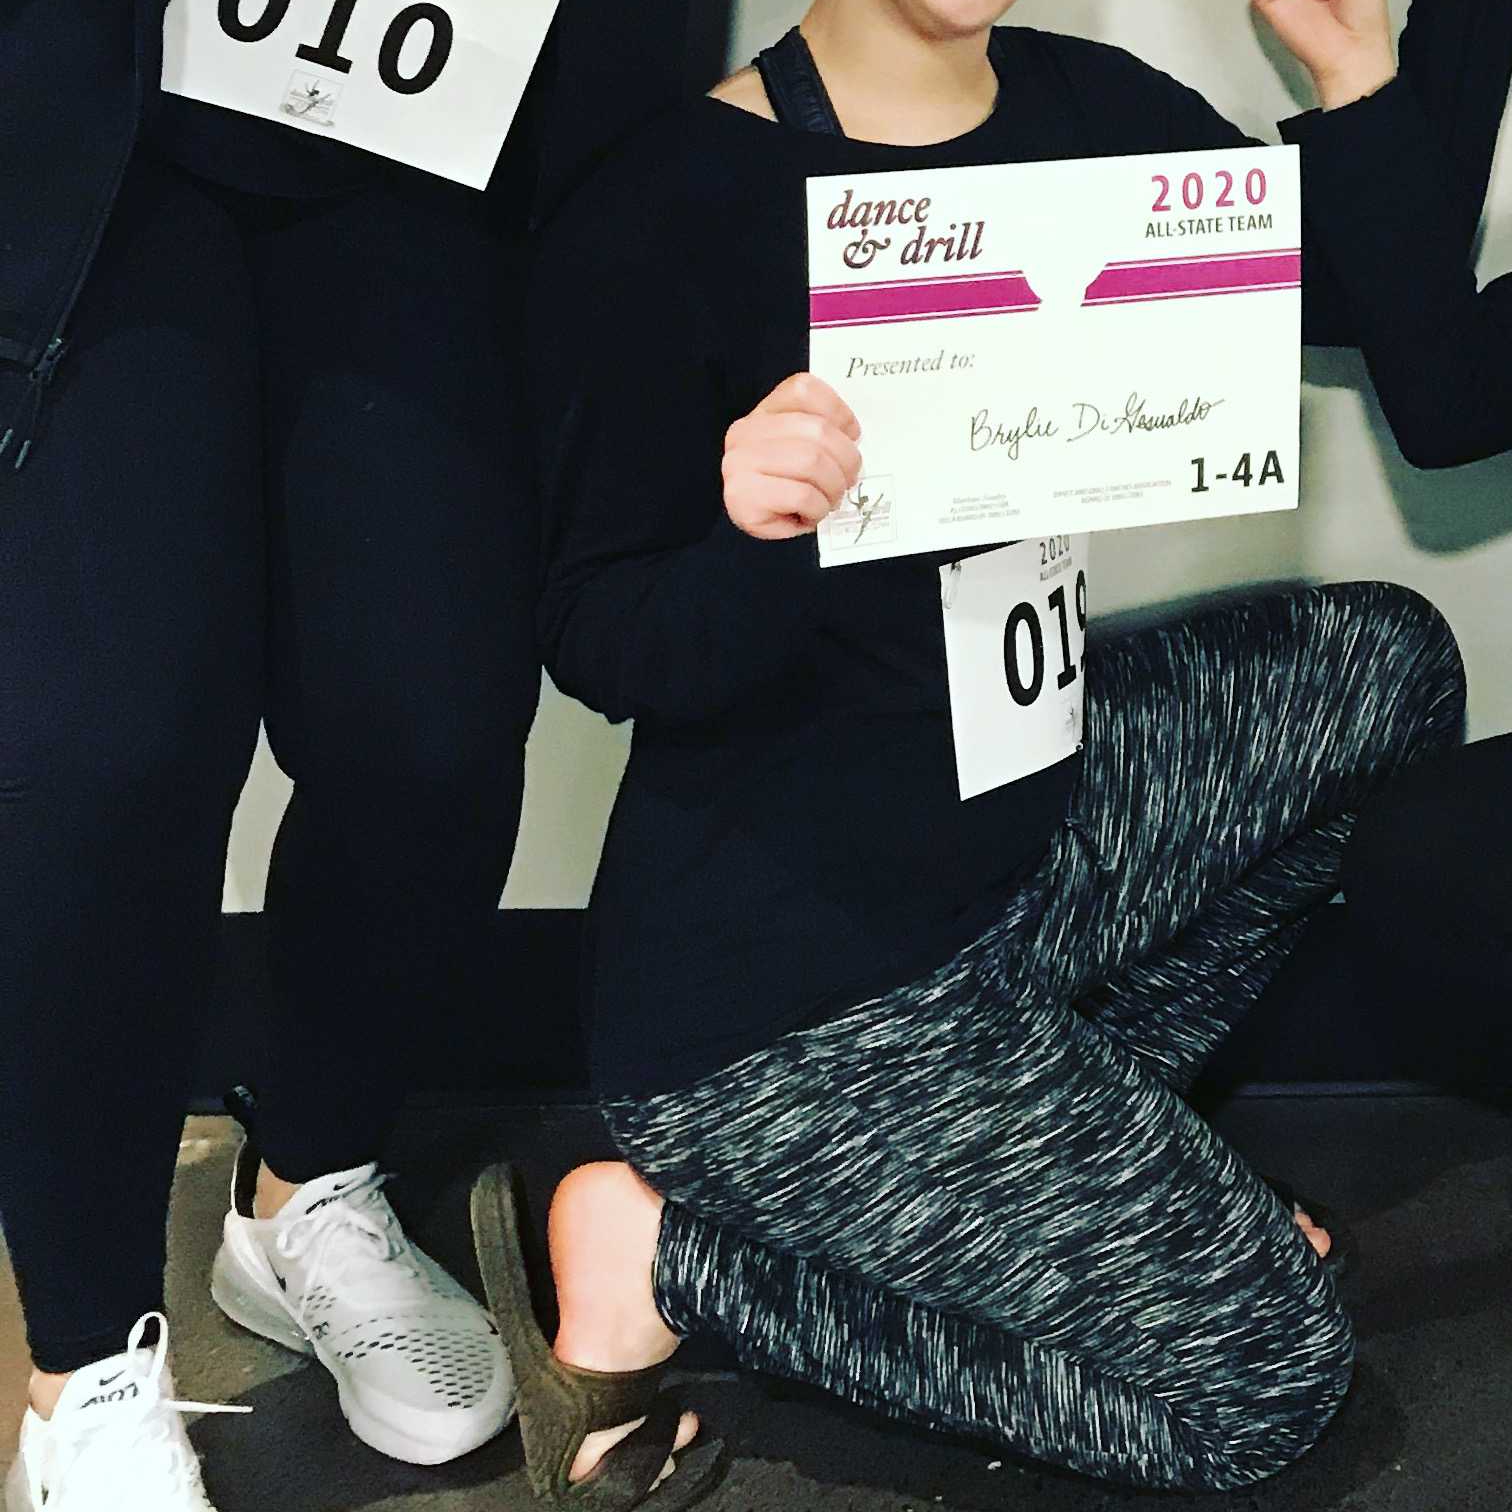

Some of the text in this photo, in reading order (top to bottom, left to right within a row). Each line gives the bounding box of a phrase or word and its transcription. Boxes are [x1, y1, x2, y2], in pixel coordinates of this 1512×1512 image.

[827, 189, 931, 229] dance
[1151, 168, 1267, 212] 2020
[843, 221, 985, 269] & drill
[1145, 214, 1273, 238] ALL-STATE TEAM
[846, 350, 975, 378] Presented to:
[1190, 450, 1284, 493] 1-4A
[1040, 535, 1070, 565] 2020
